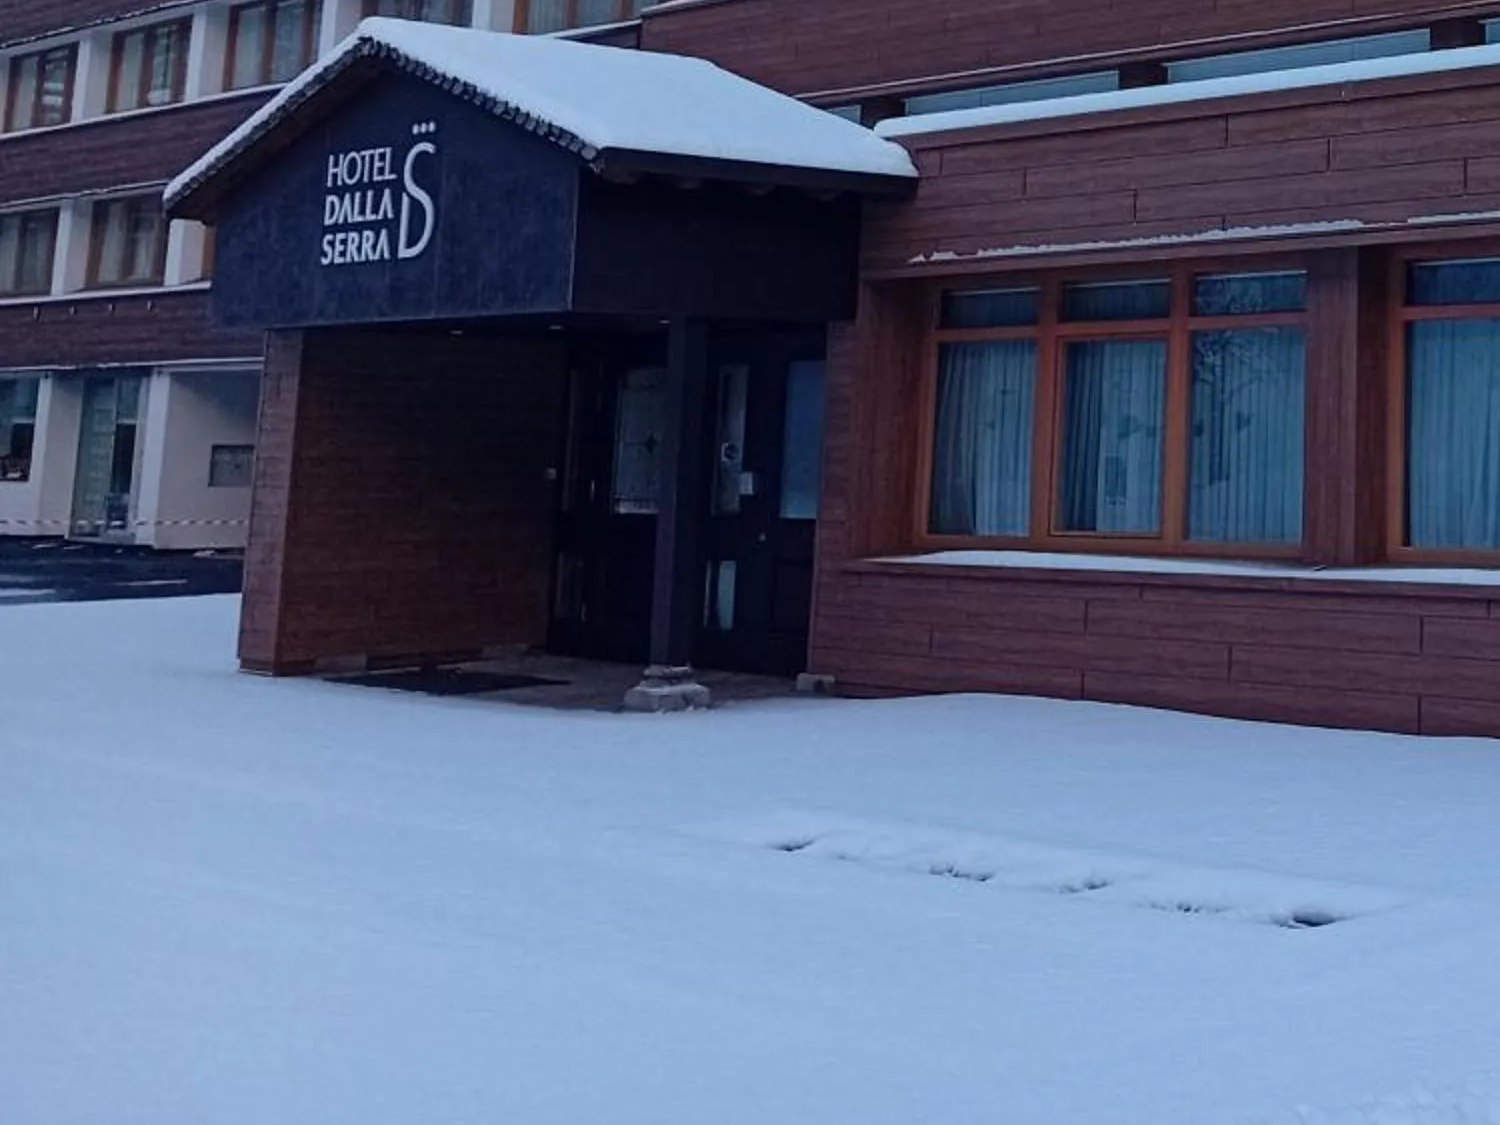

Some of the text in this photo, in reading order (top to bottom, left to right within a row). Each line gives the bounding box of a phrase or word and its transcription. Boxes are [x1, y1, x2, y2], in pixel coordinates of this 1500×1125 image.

[326, 146, 398, 188] HOTEL
[323, 187, 395, 226] DALLA
[320, 228, 391, 266] SERRA
